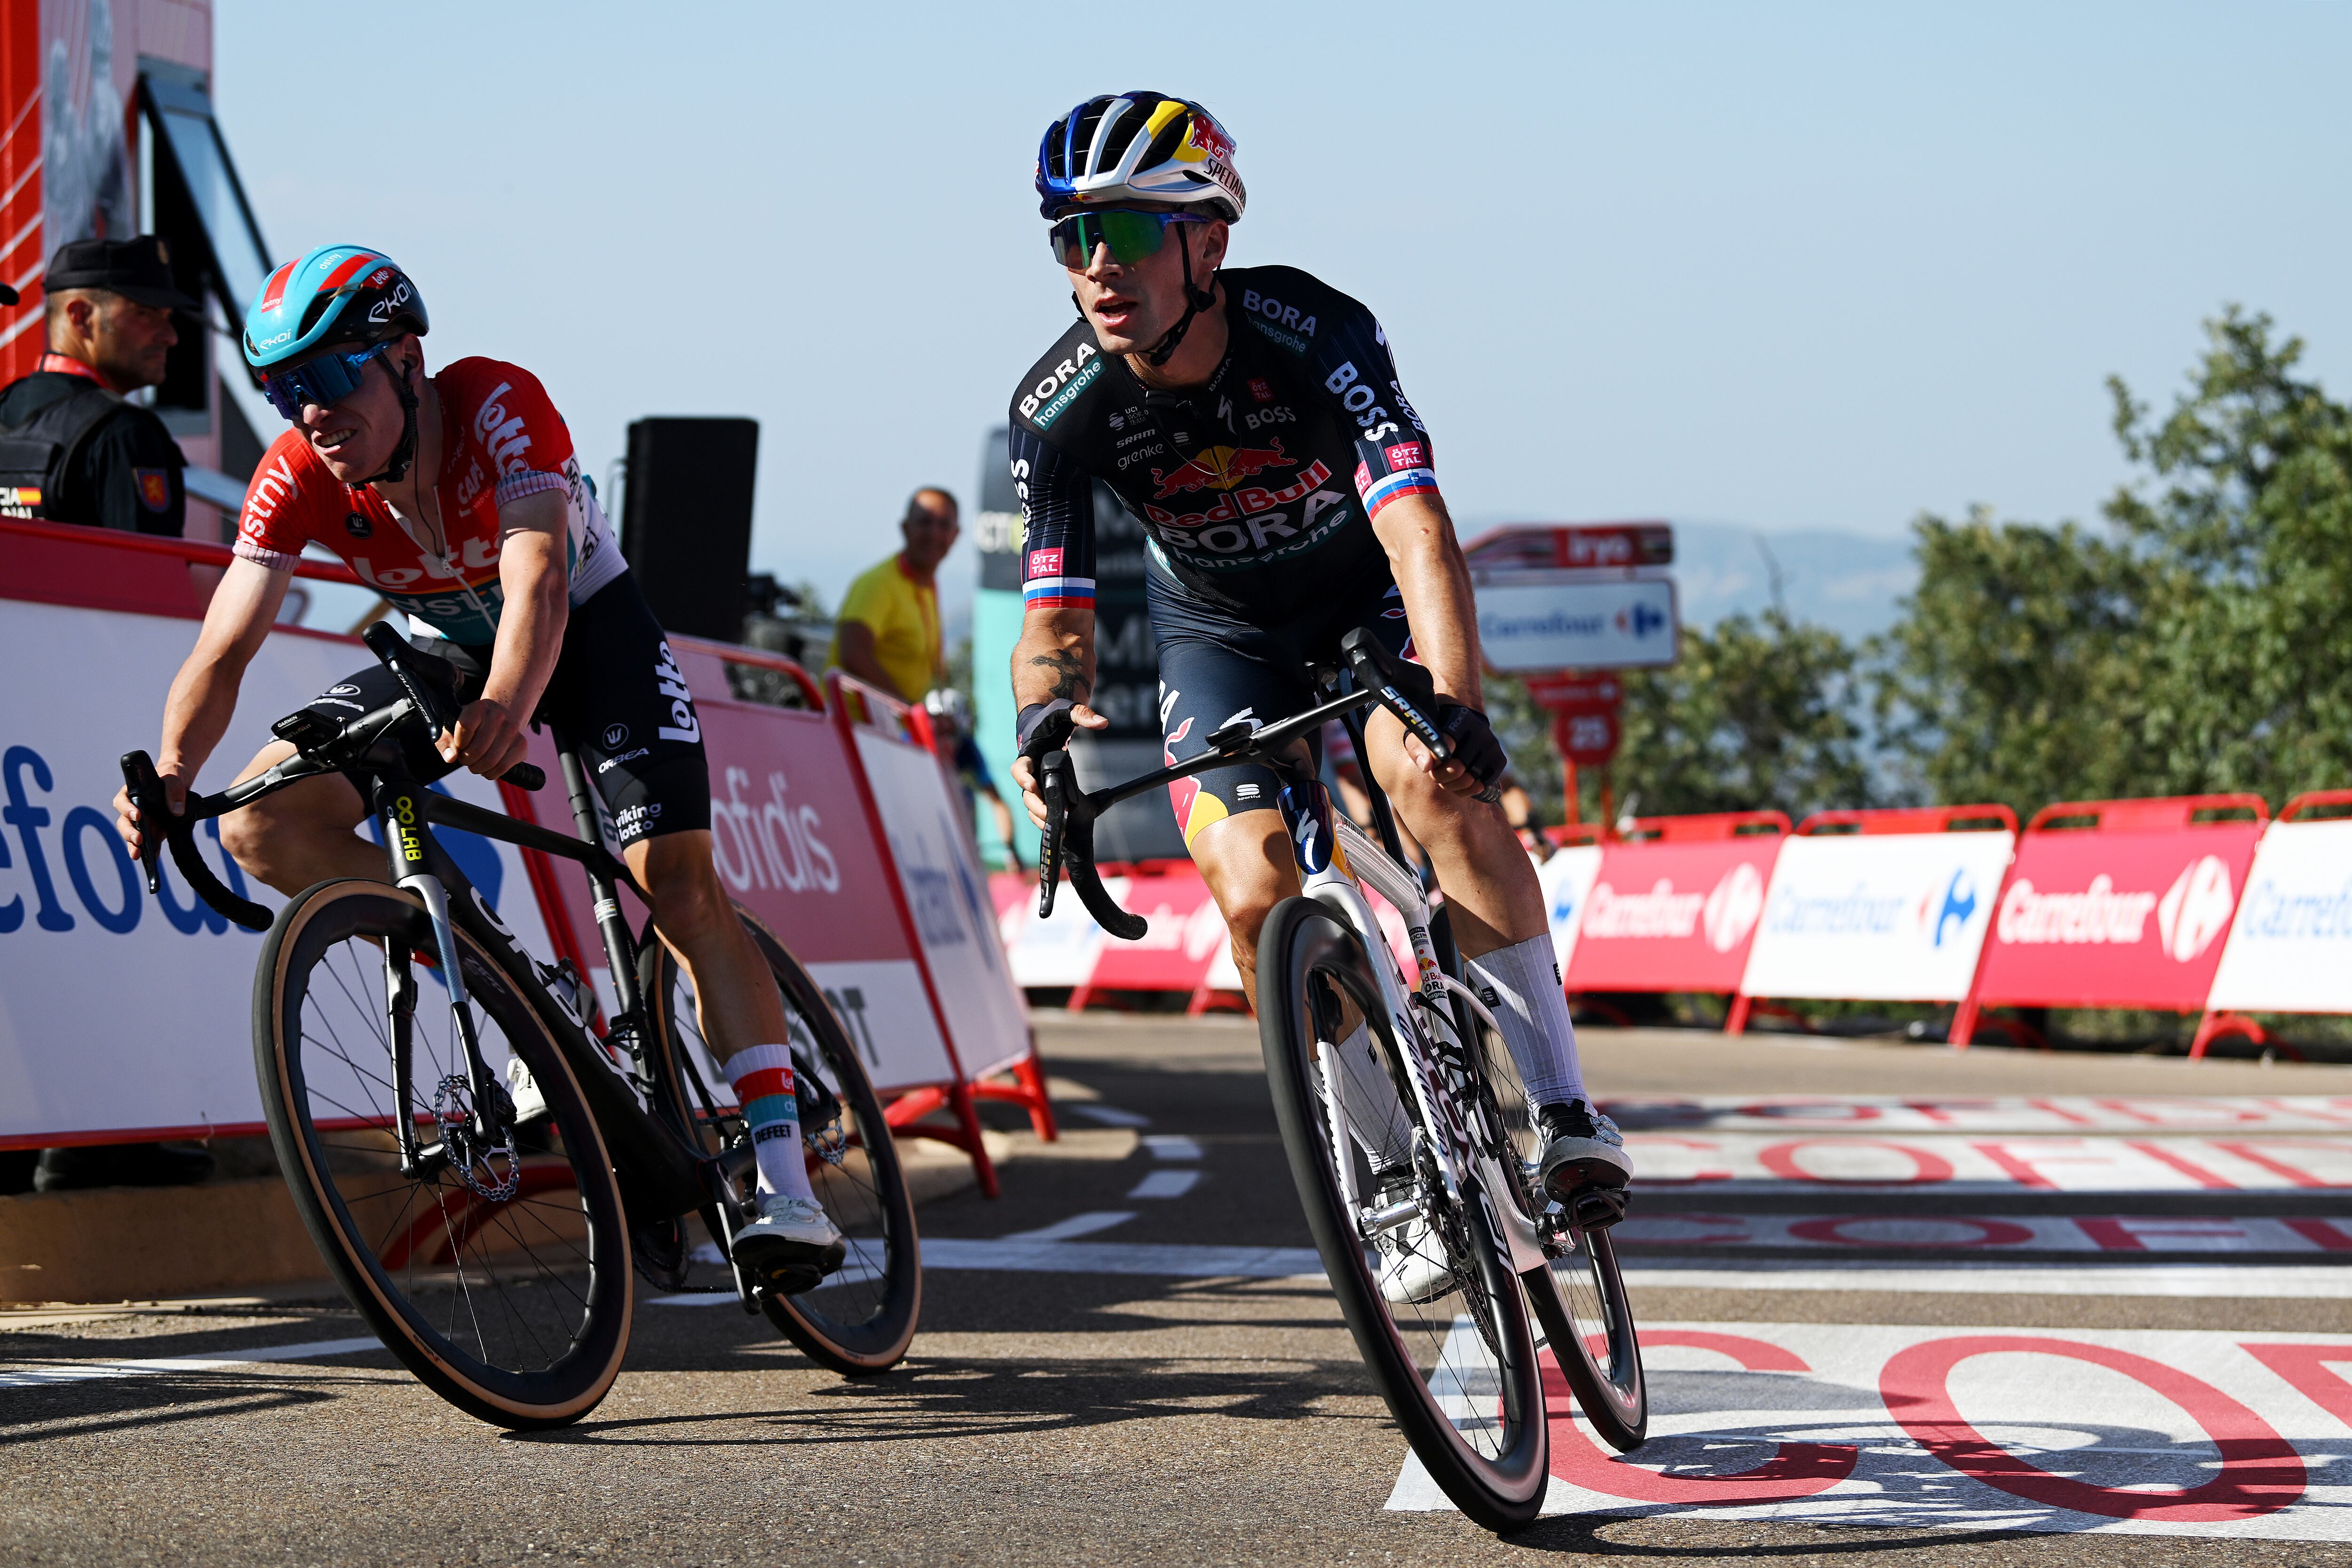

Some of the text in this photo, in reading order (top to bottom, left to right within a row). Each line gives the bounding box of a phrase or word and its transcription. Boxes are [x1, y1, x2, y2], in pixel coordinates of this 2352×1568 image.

[1242, 288, 1316, 337] BORA
[1247, 312, 1306, 353] hansgrohe
[1018, 342, 1097, 419] BORA
[1034, 362, 1101, 426] hansgrohe
[1245, 406, 1296, 429] BOSS
[1325, 361, 1399, 442] BOSS
[1390, 380, 1427, 434] BORA
[1117, 429, 1155, 448] SRAM
[1392, 446, 1420, 458] ÖTZ
[1118, 443, 1164, 470] grenke
[1394, 456, 1422, 466] TAL
[1143, 459, 1332, 527] Red Bull
[1156, 490, 1346, 554] BORA
[1173, 510, 1347, 568] hansgrohe
[1032, 554, 1058, 565] ÖTZ
[1032, 563, 1058, 574] TAL
[278, 715, 298, 728] GARMIN
[1380, 685, 1438, 741] SRAM
[598, 747, 649, 774] ORBEA
[615, 802, 662, 828] viking
[619, 820, 654, 842] lotto
[711, 765, 841, 894] ofidis
[1040, 823, 1052, 898] SRAM
[1997, 872, 2157, 944] Carrefour
[1425, 981, 1445, 995] ORA
[755, 1124, 791, 1145] DEFEET
